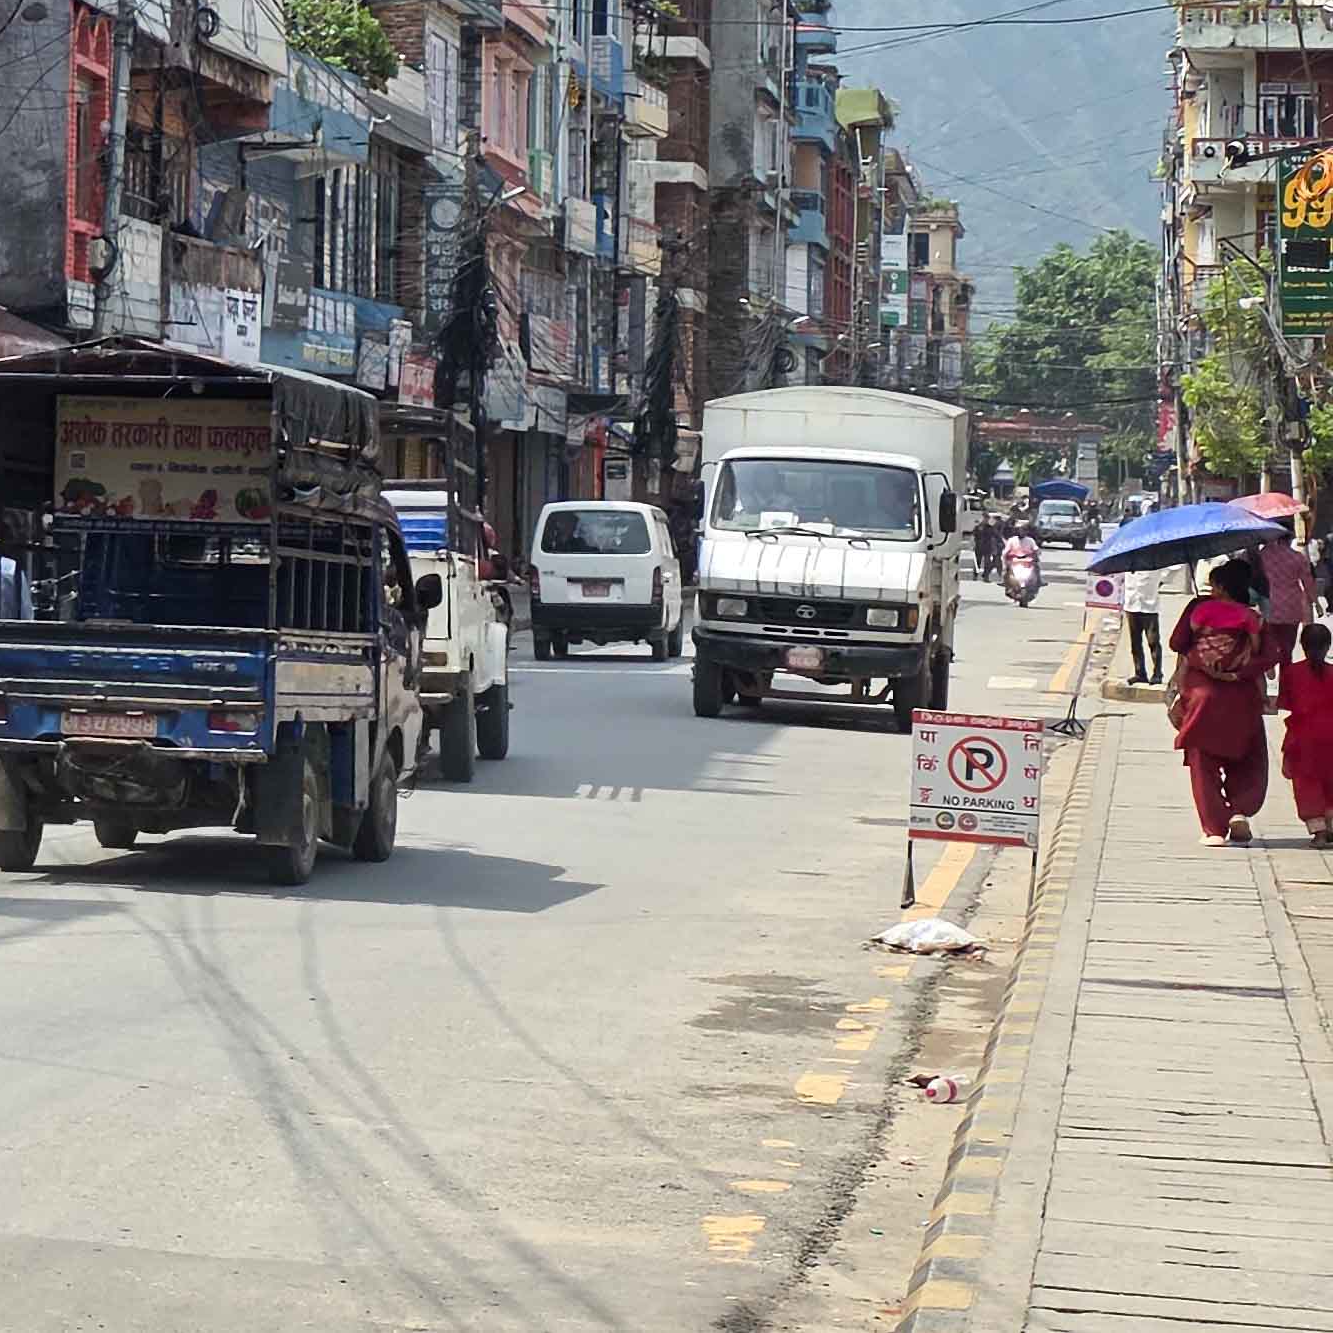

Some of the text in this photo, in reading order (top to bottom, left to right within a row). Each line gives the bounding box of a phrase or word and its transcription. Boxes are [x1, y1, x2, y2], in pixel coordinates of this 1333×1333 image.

[111, 416, 169, 449] तरकारी
[942, 795, 1016, 811] NO PARKING
